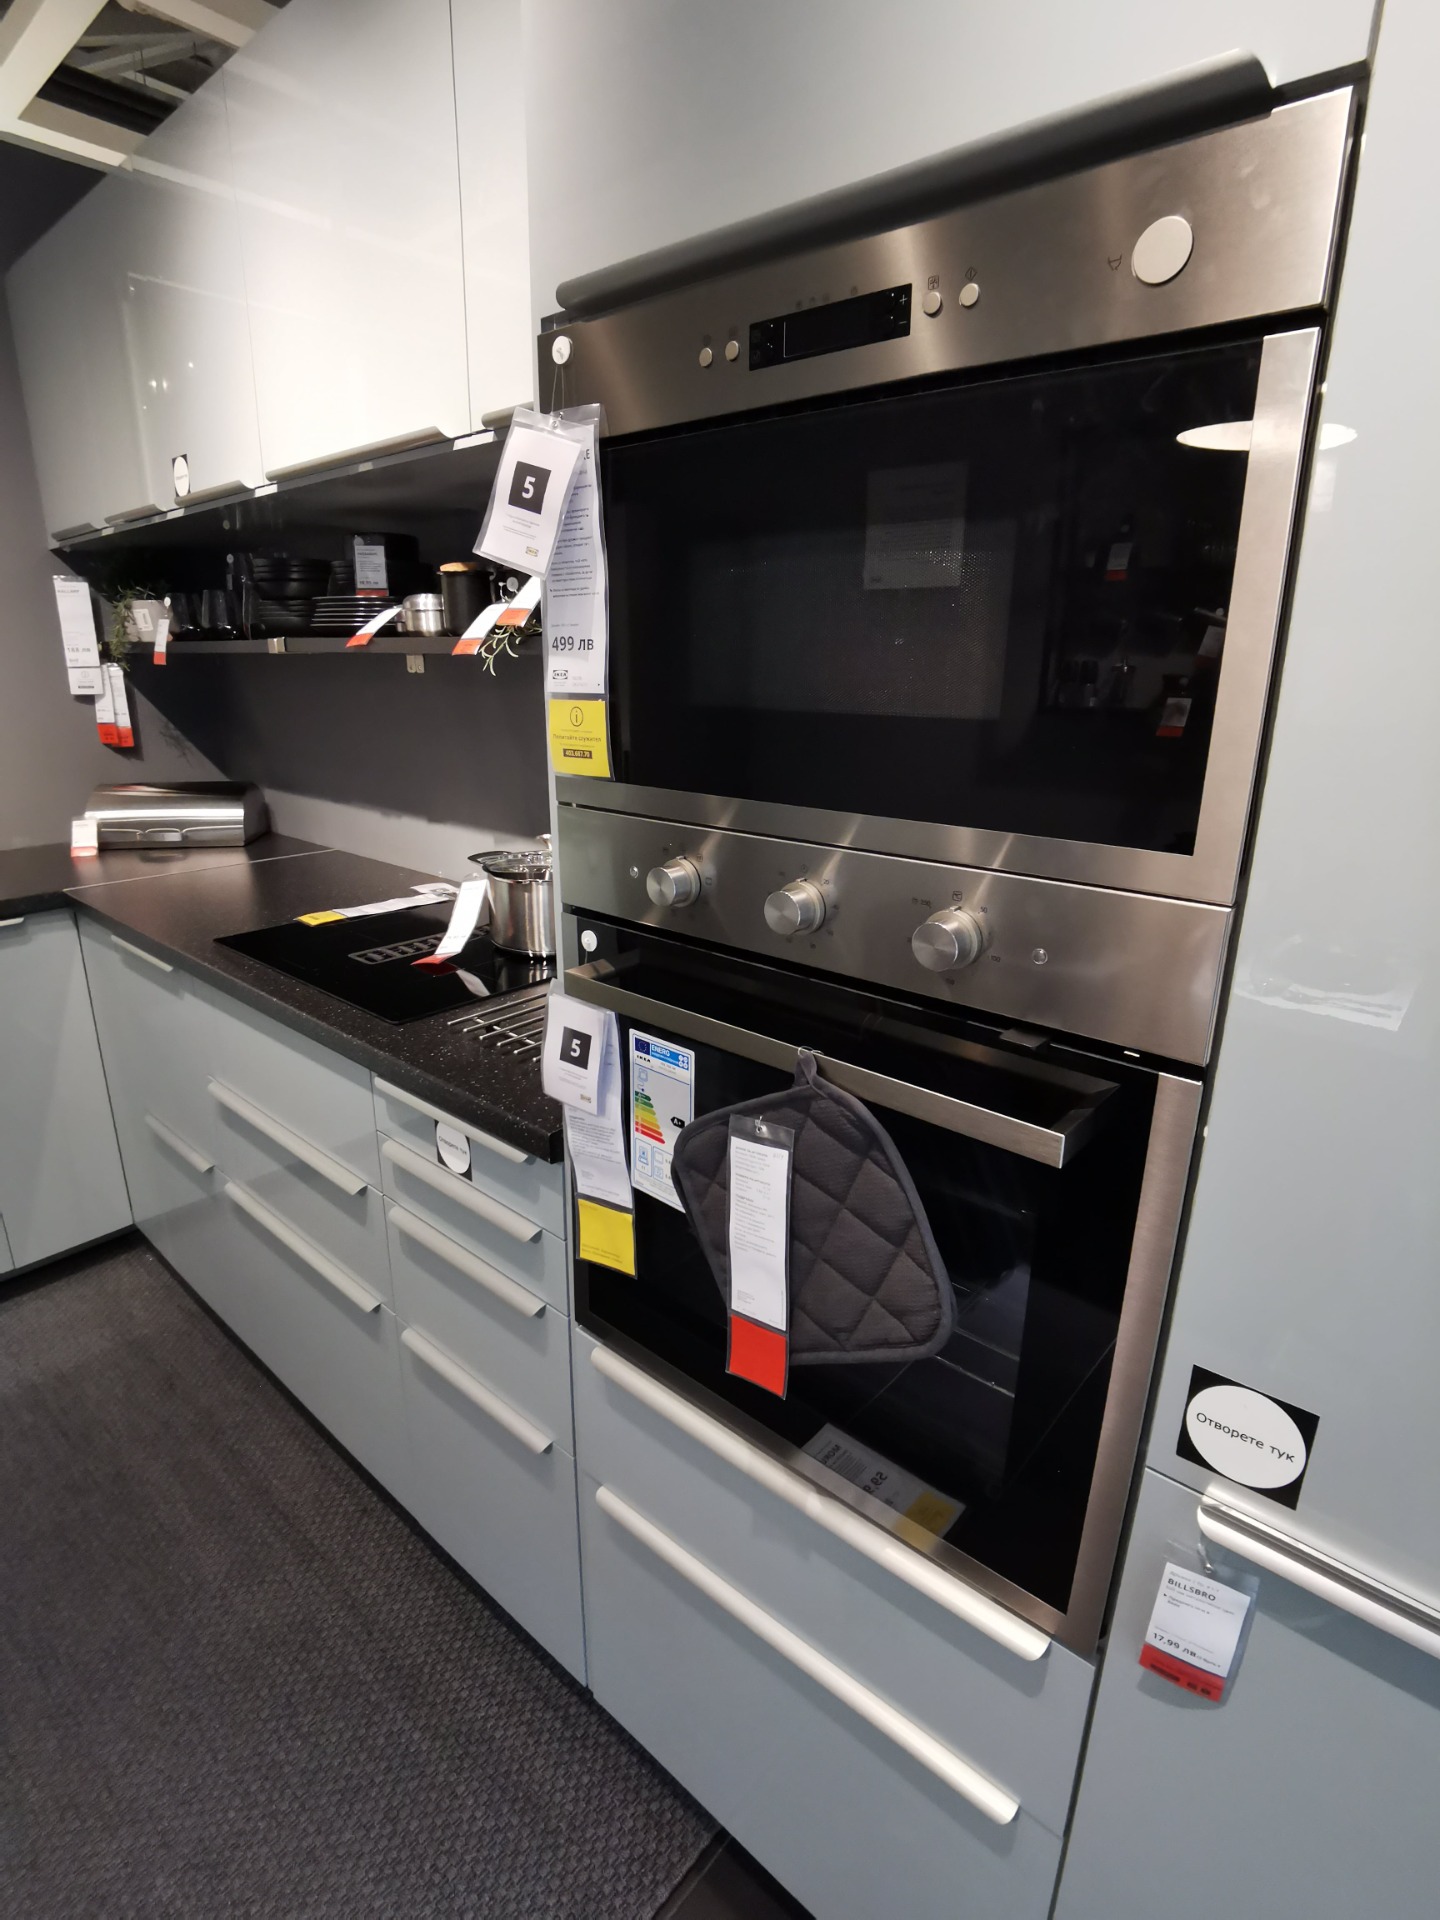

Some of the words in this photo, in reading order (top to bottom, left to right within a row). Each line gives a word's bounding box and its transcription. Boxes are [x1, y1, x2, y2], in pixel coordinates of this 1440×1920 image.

[522, 475, 536, 499] 5
[552, 635, 575, 651] 499
[570, 1038, 581, 1058] 5
[636, 1054, 651, 1063] IKEA
[1196, 1412, 1265, 1450] Отворете
[1269, 1445, 1296, 1463] тук
[1167, 1578, 1217, 1602] BILLSBRO
